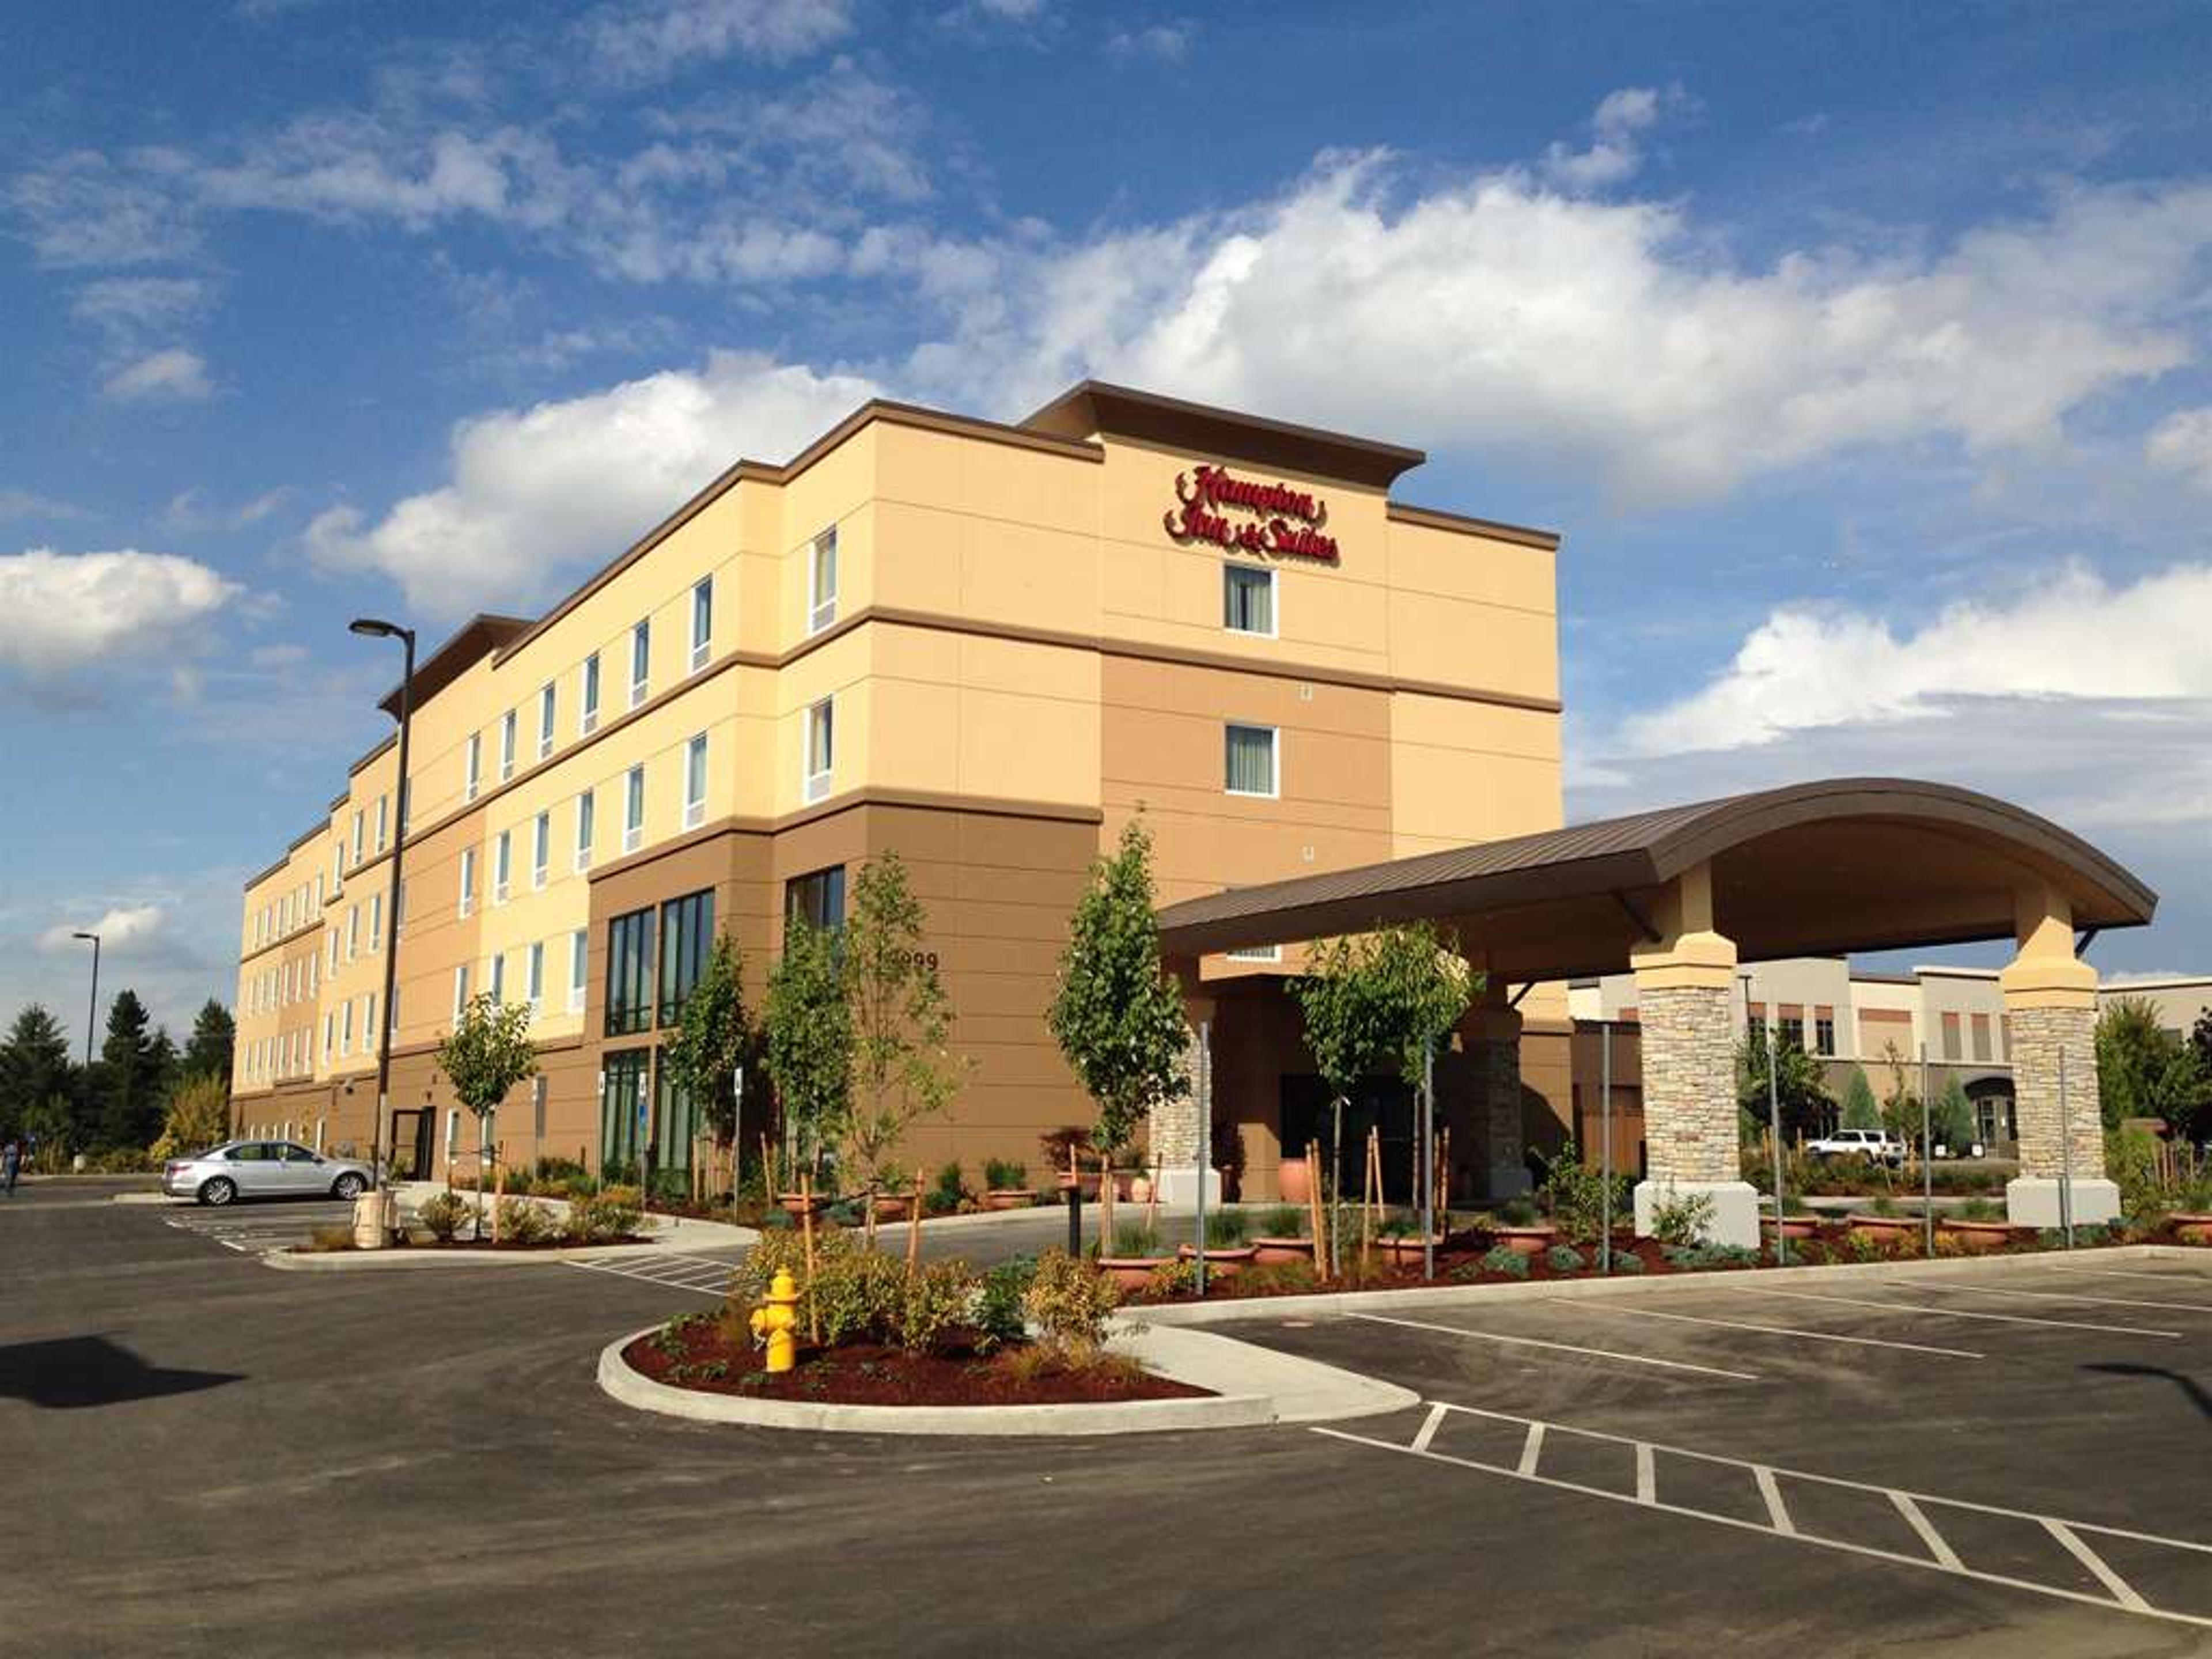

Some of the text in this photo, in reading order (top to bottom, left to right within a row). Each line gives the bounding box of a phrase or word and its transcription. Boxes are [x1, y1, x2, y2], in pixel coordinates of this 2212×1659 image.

[1175, 465, 1327, 525] Hampton
[1164, 503, 1339, 565] Inn & Suites
